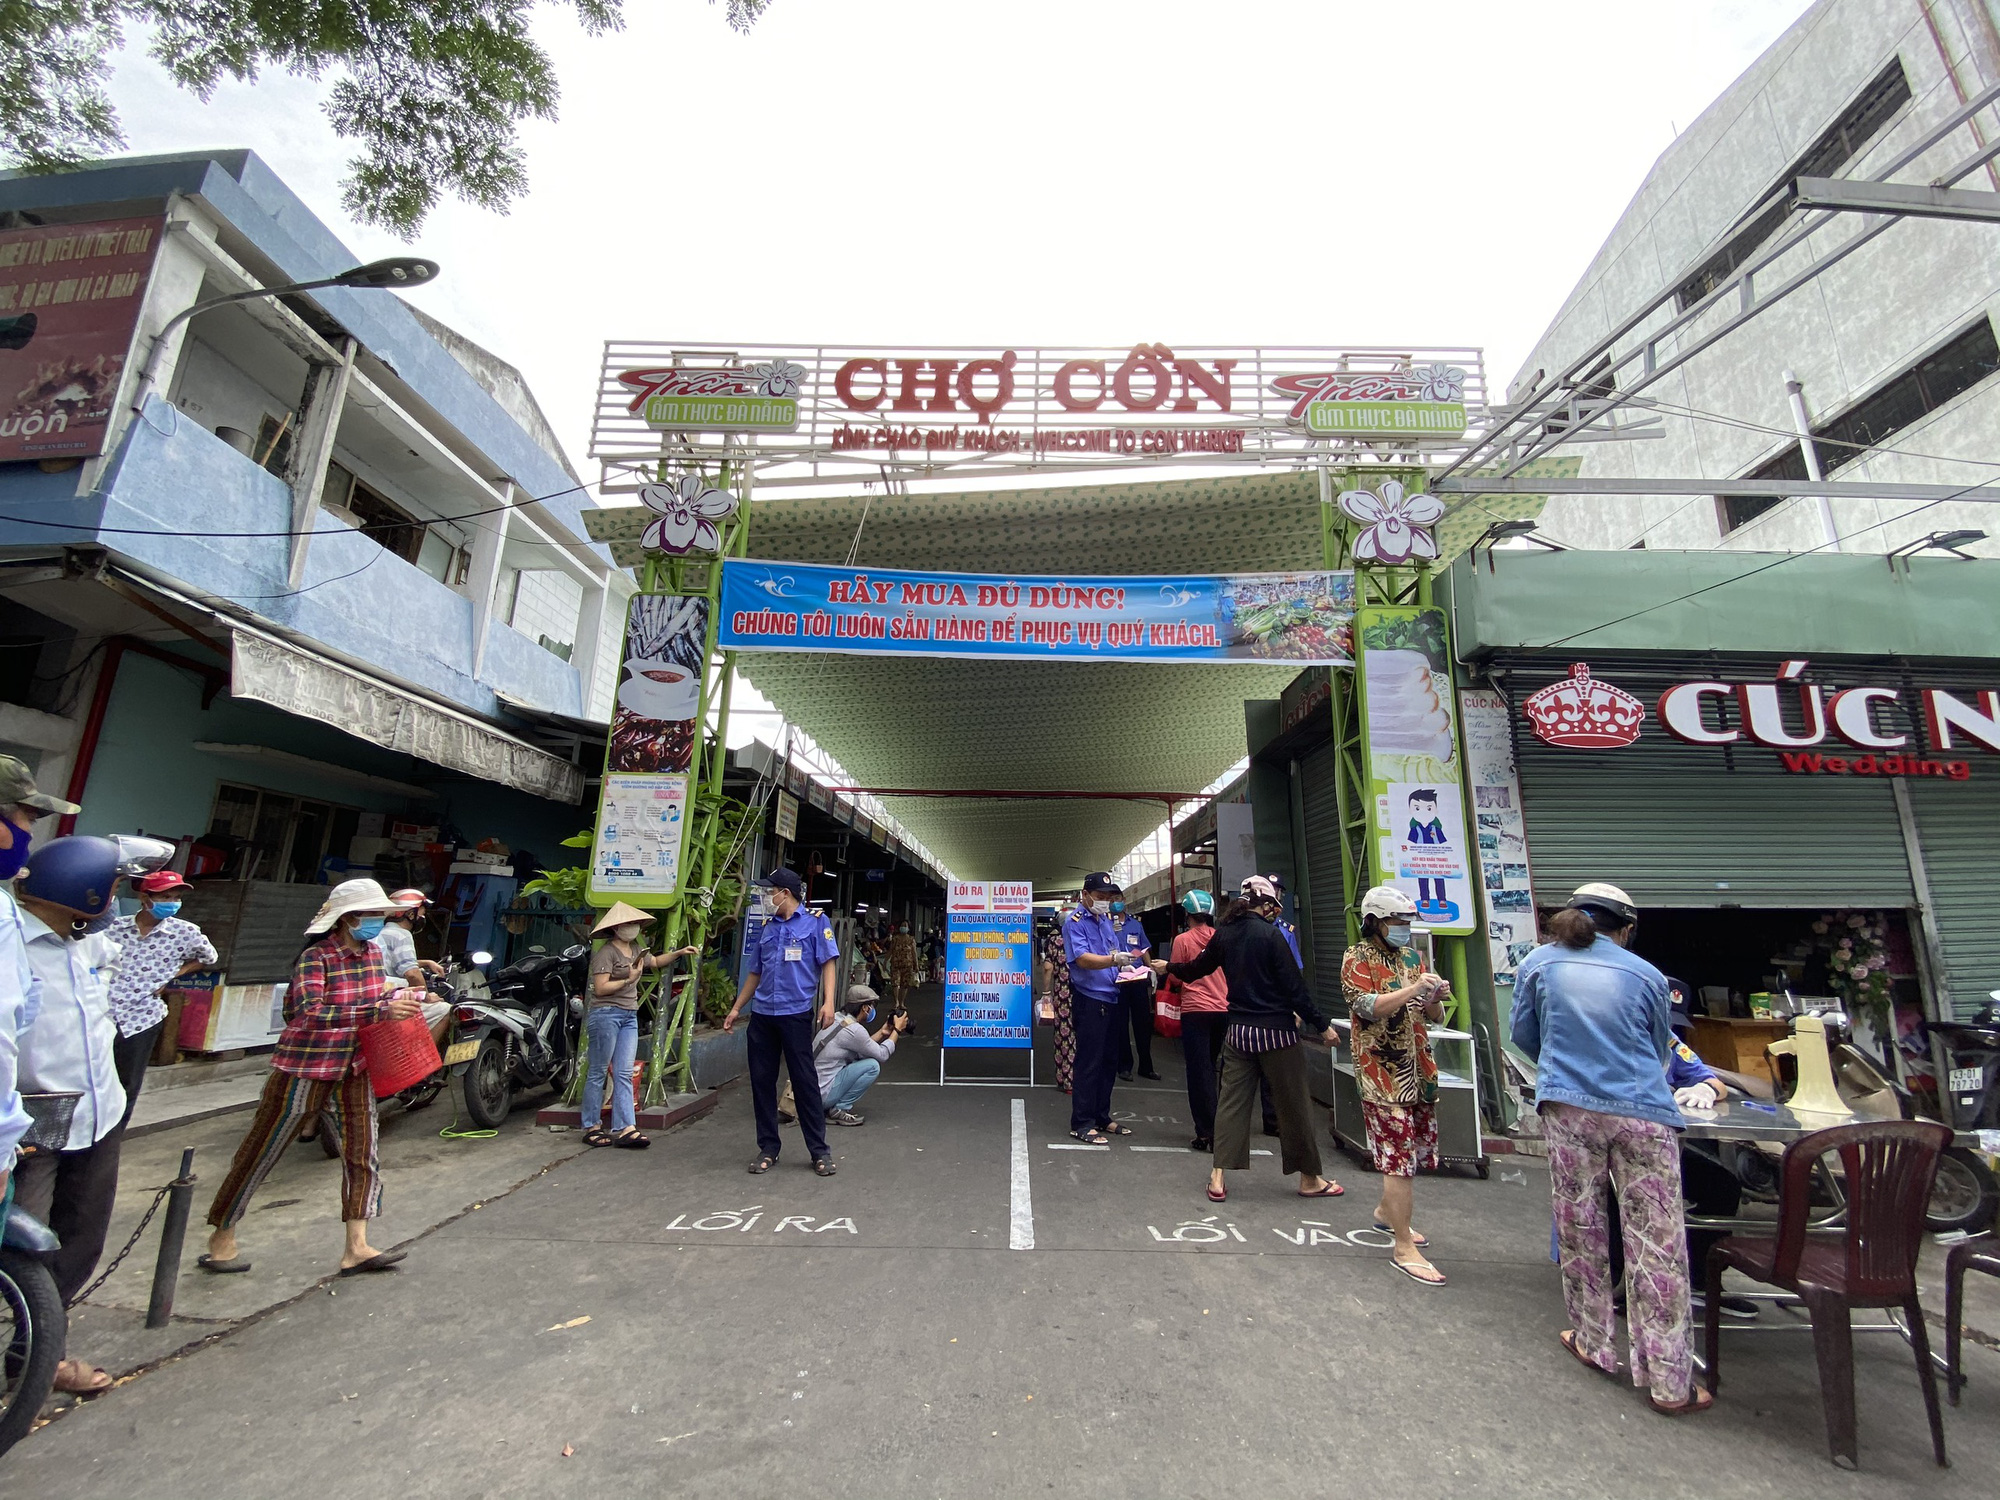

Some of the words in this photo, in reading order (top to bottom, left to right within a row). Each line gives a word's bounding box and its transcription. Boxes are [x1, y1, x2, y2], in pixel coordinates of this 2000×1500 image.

[834, 350, 1016, 425] CHỢ
[1053, 342, 1238, 412] CỒN
[681, 403, 723, 424] THỰC
[726, 400, 748, 422] ĐÀ
[750, 400, 793, 423] NẴNG
[1316, 402, 1344, 427] ẨM
[1346, 408, 1392, 430] THỰC
[1394, 405, 1417, 427] ĐÀ
[1419, 405, 1464, 428] NẴNG
[832, 421, 870, 450] KÍNH
[874, 422, 922, 450] CHÀO
[926, 423, 959, 450] QUÝ
[964, 423, 1021, 451] KHÁCH
[1034, 430, 1111, 453] WELCOME
[1117, 430, 1136, 452] TO
[1141, 430, 1178, 453] CON
[1179, 430, 1245, 454] MARKET
[828, 574, 896, 605] HÃY
[900, 582, 968, 607] MUA
[977, 580, 1021, 608] ĐỦ
[1028, 581, 1125, 610] DÙNG!
[733, 607, 797, 635] CHÚNG
[802, 610, 830, 637] TÔI
[835, 612, 885, 639] LUÔN
[890, 610, 929, 640] SẴN
[933, 612, 986, 642] HÀNG
[991, 611, 1016, 642] ĐỂ
[1020, 620, 1073, 648] PHỤC
[1077, 621, 1101, 649] VỤ
[1107, 618, 1144, 648] QUÝ
[1150, 620, 1221, 648] KHÁCH.
[1465, 695, 1487, 708] CÚC
[1656, 661, 1906, 750] CÚC
[1779, 752, 1969, 781] Wedding
[954, 883, 968, 896] LỐI
[971, 886, 983, 896] RA
[994, 883, 1008, 896] LỐI
[1010, 884, 1028, 896] VÀO
[952, 915, 966, 923] BAN
[997, 915, 1011, 925] CHỢ
[950, 931, 971, 943] CHUNG
[972, 932, 982, 943] TAY
[1008, 928, 1028, 944] CHỐNG
[965, 947, 980, 962] DỊCH
[981, 947, 999, 959] COVID
[1005, 948, 1013, 960] 19
[948, 967, 962, 984] YÊU
[964, 966, 979, 984] CẦU
[980, 972, 993, 984] KHI
[995, 969, 1010, 984] VÀO
[951, 992, 963, 1002] ĐEO
[963, 988, 980, 1002] KHẨU
[981, 992, 1000, 1003] TRANG
[950, 1006, 963, 1020] RỬA
[963, 1009, 973, 1020] TAY
[974, 1007, 986, 1020] SÁT
[987, 1006, 1007, 1020] KHUẨN
[950, 1024, 961, 1038] GIỮ
[961, 1023, 985, 1038] KHOẢNG
[986, 1025, 1003, 1038] CÁCH
[1004, 1027, 1013, 1038] AN
[1013, 1025, 1030, 1039] TOÀN
[664, 1204, 766, 1234] LỐI
[771, 1214, 860, 1235] RA
[1146, 1215, 1248, 1244] LỐI
[1270, 1220, 1402, 1249] VÀO
